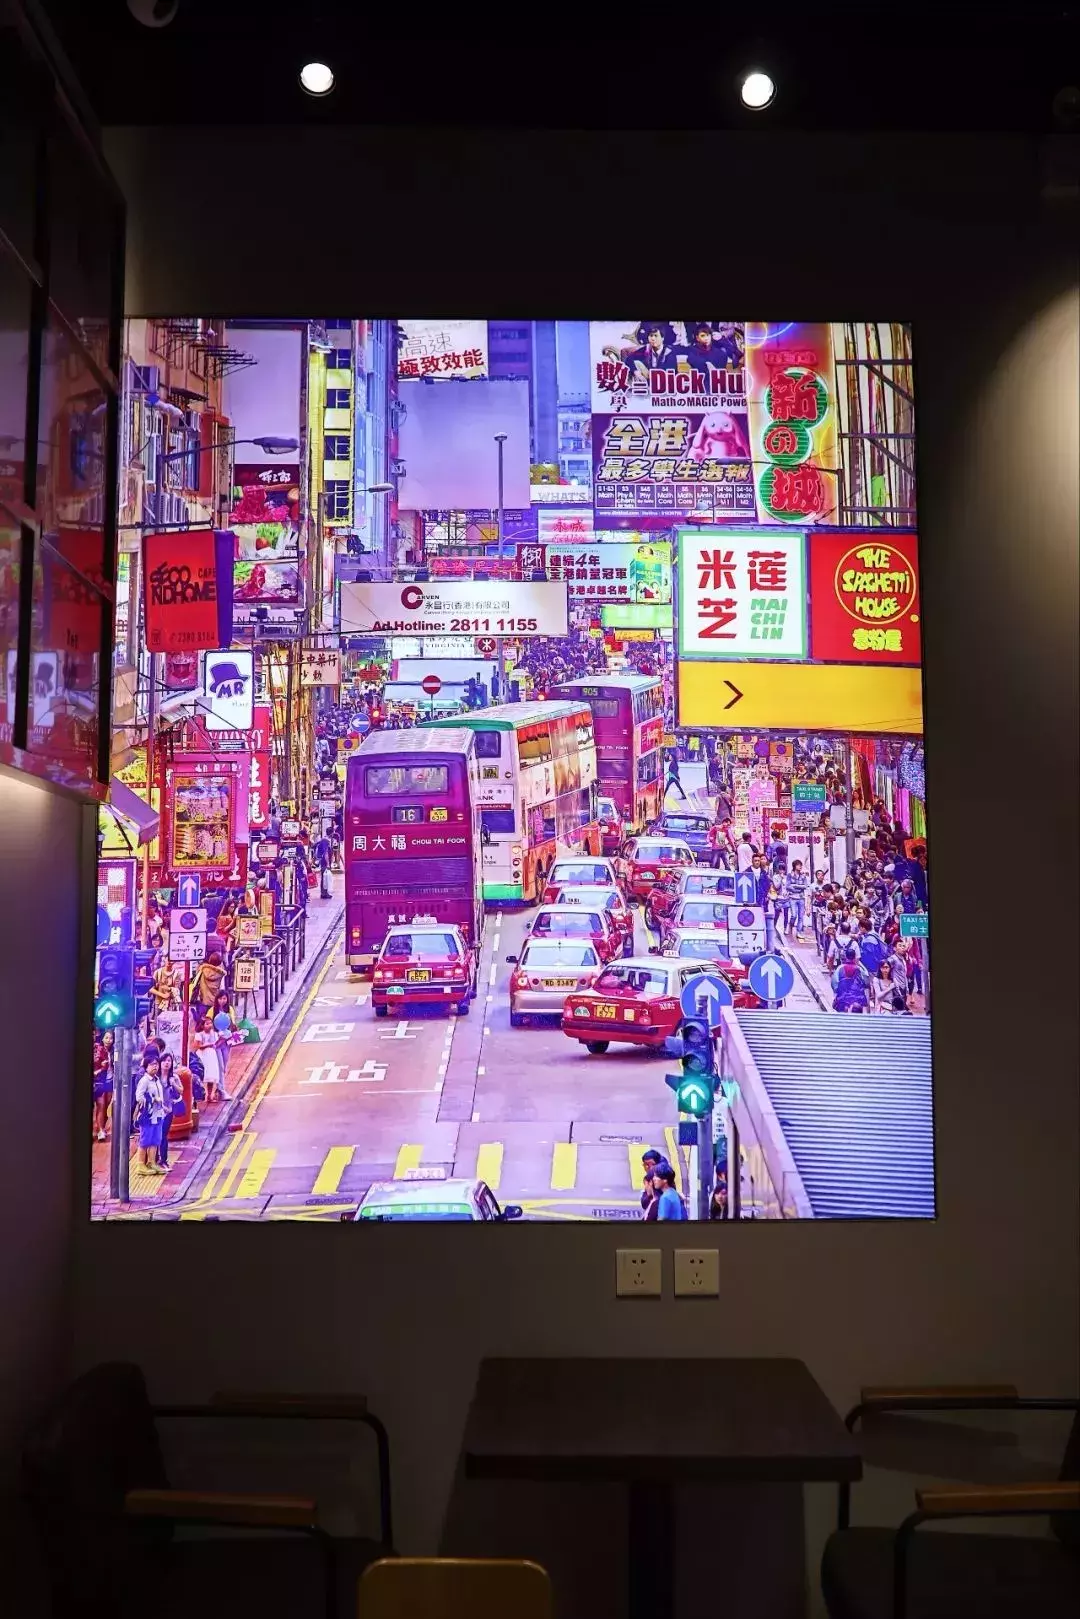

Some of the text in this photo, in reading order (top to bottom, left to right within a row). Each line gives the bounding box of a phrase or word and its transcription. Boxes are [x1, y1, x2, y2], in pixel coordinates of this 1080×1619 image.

[398, 349, 484, 376] 極致效能
[651, 370, 705, 394] Dick
[604, 418, 689, 457] 全港
[856, 548, 891, 568] THE
[750, 598, 788, 611] MAI
[855, 596, 901, 618] HOUSE
[393, 620, 446, 632] Hotline:
[450, 618, 490, 631] 2811
[496, 618, 538, 631] 1155
[750, 612, 785, 625] CHI
[750, 627, 783, 640] LIN
[401, 809, 416, 822] 16
[352, 834, 407, 851] 周大福
[752, 933, 757, 941] 7
[193, 949, 203, 957] 12
[407, 1170, 442, 1178] TAXI
